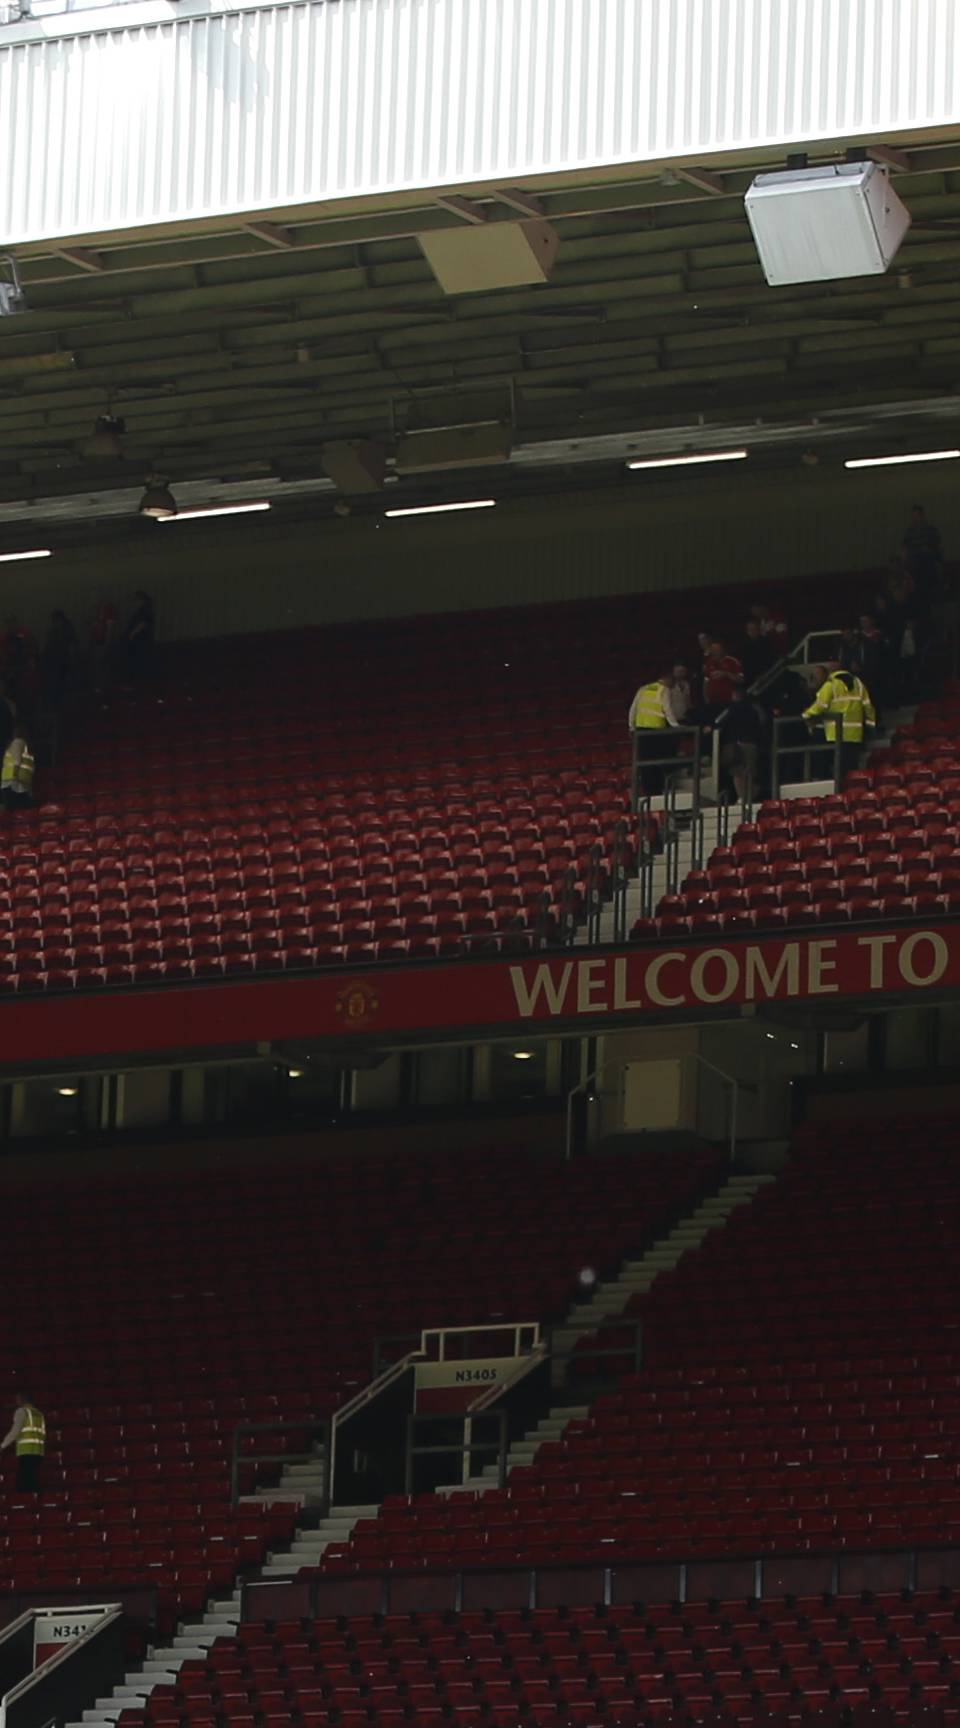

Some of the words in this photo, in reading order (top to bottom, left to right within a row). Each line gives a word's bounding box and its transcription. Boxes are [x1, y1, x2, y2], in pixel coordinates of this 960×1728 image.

[510, 939, 839, 1017] WELCOME
[858, 931, 949, 987] TO
[456, 1369, 497, 1382] N3405
[53, 1625, 94, 1637] N34
